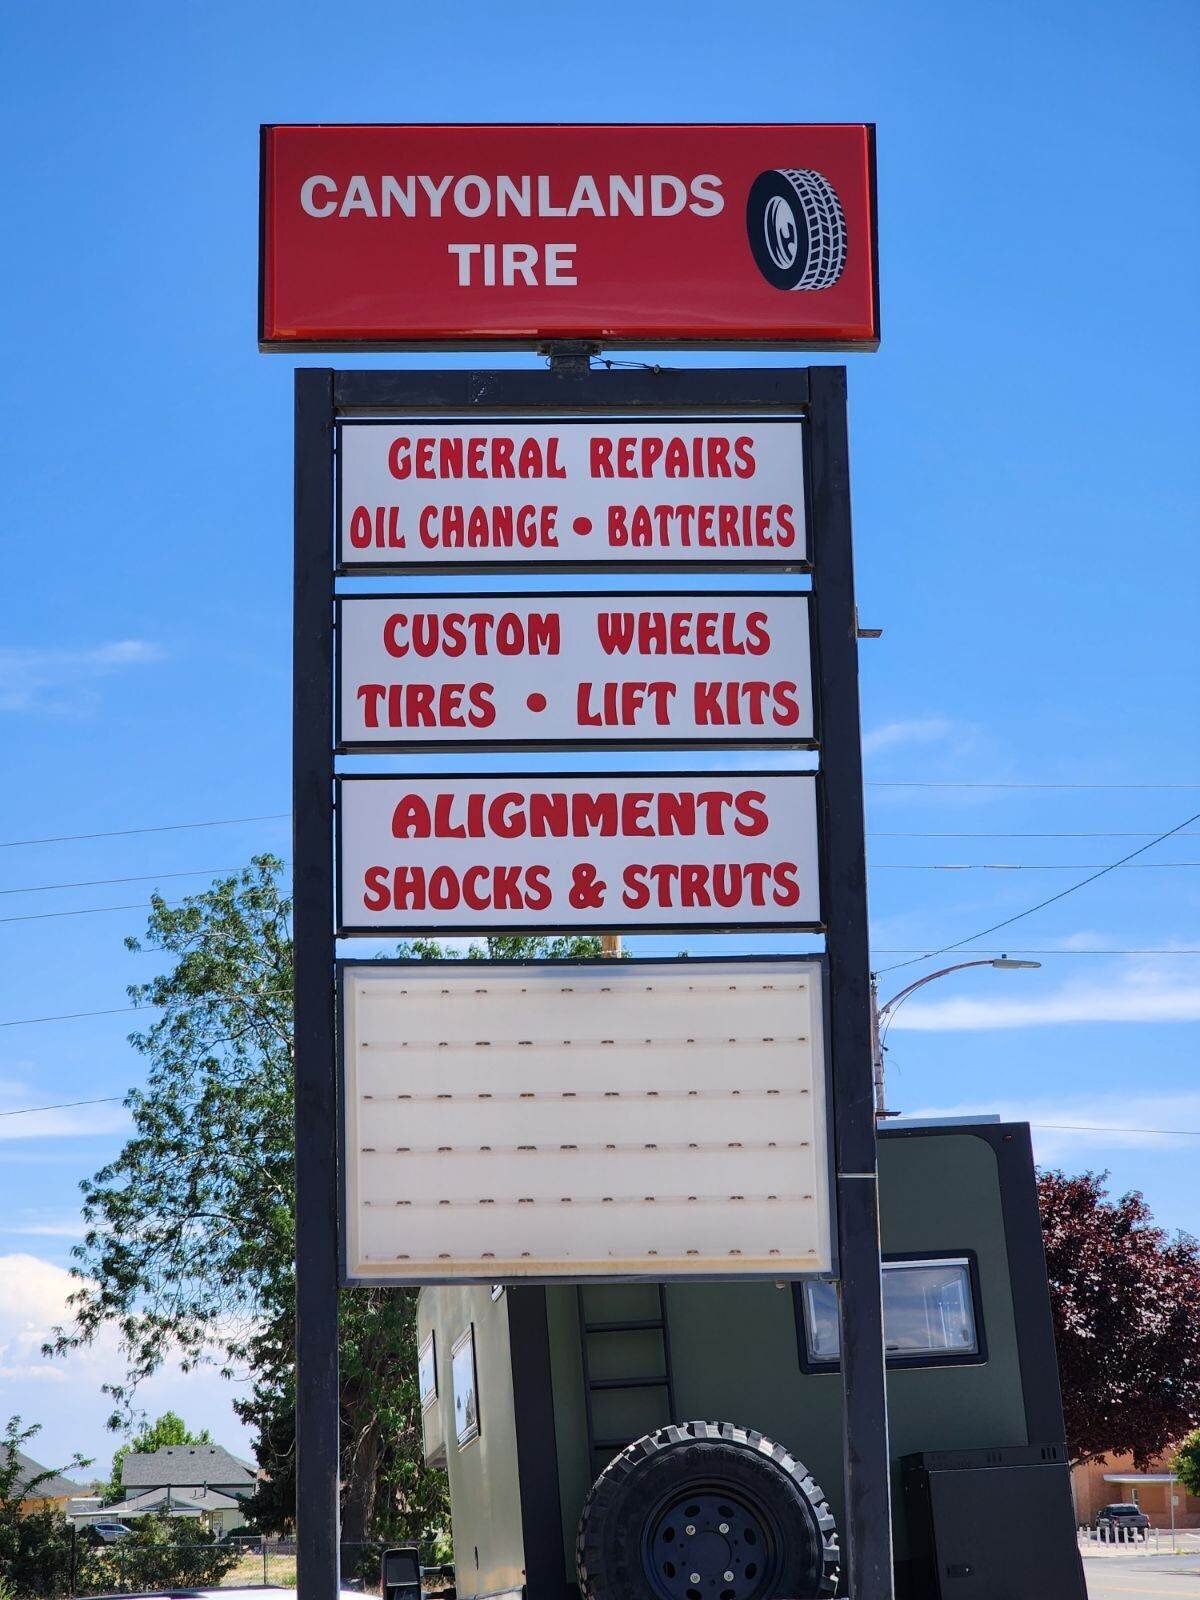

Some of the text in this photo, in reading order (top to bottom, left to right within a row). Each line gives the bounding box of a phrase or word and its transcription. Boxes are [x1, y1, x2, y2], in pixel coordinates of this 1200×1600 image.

[300, 174, 725, 218] CANYONLANDS
[448, 243, 578, 286] TIRE
[388, 436, 756, 479] GENERAL REPAIRS
[350, 504, 796, 549] OIL CHANGE BATTERIES
[383, 612, 771, 658] CUSTOM WHEELS
[357, 681, 799, 728] TIRES LIFT KITS
[391, 790, 769, 840] ALIGNMENTS
[364, 862, 800, 912] SHOCKS & STRUTS
